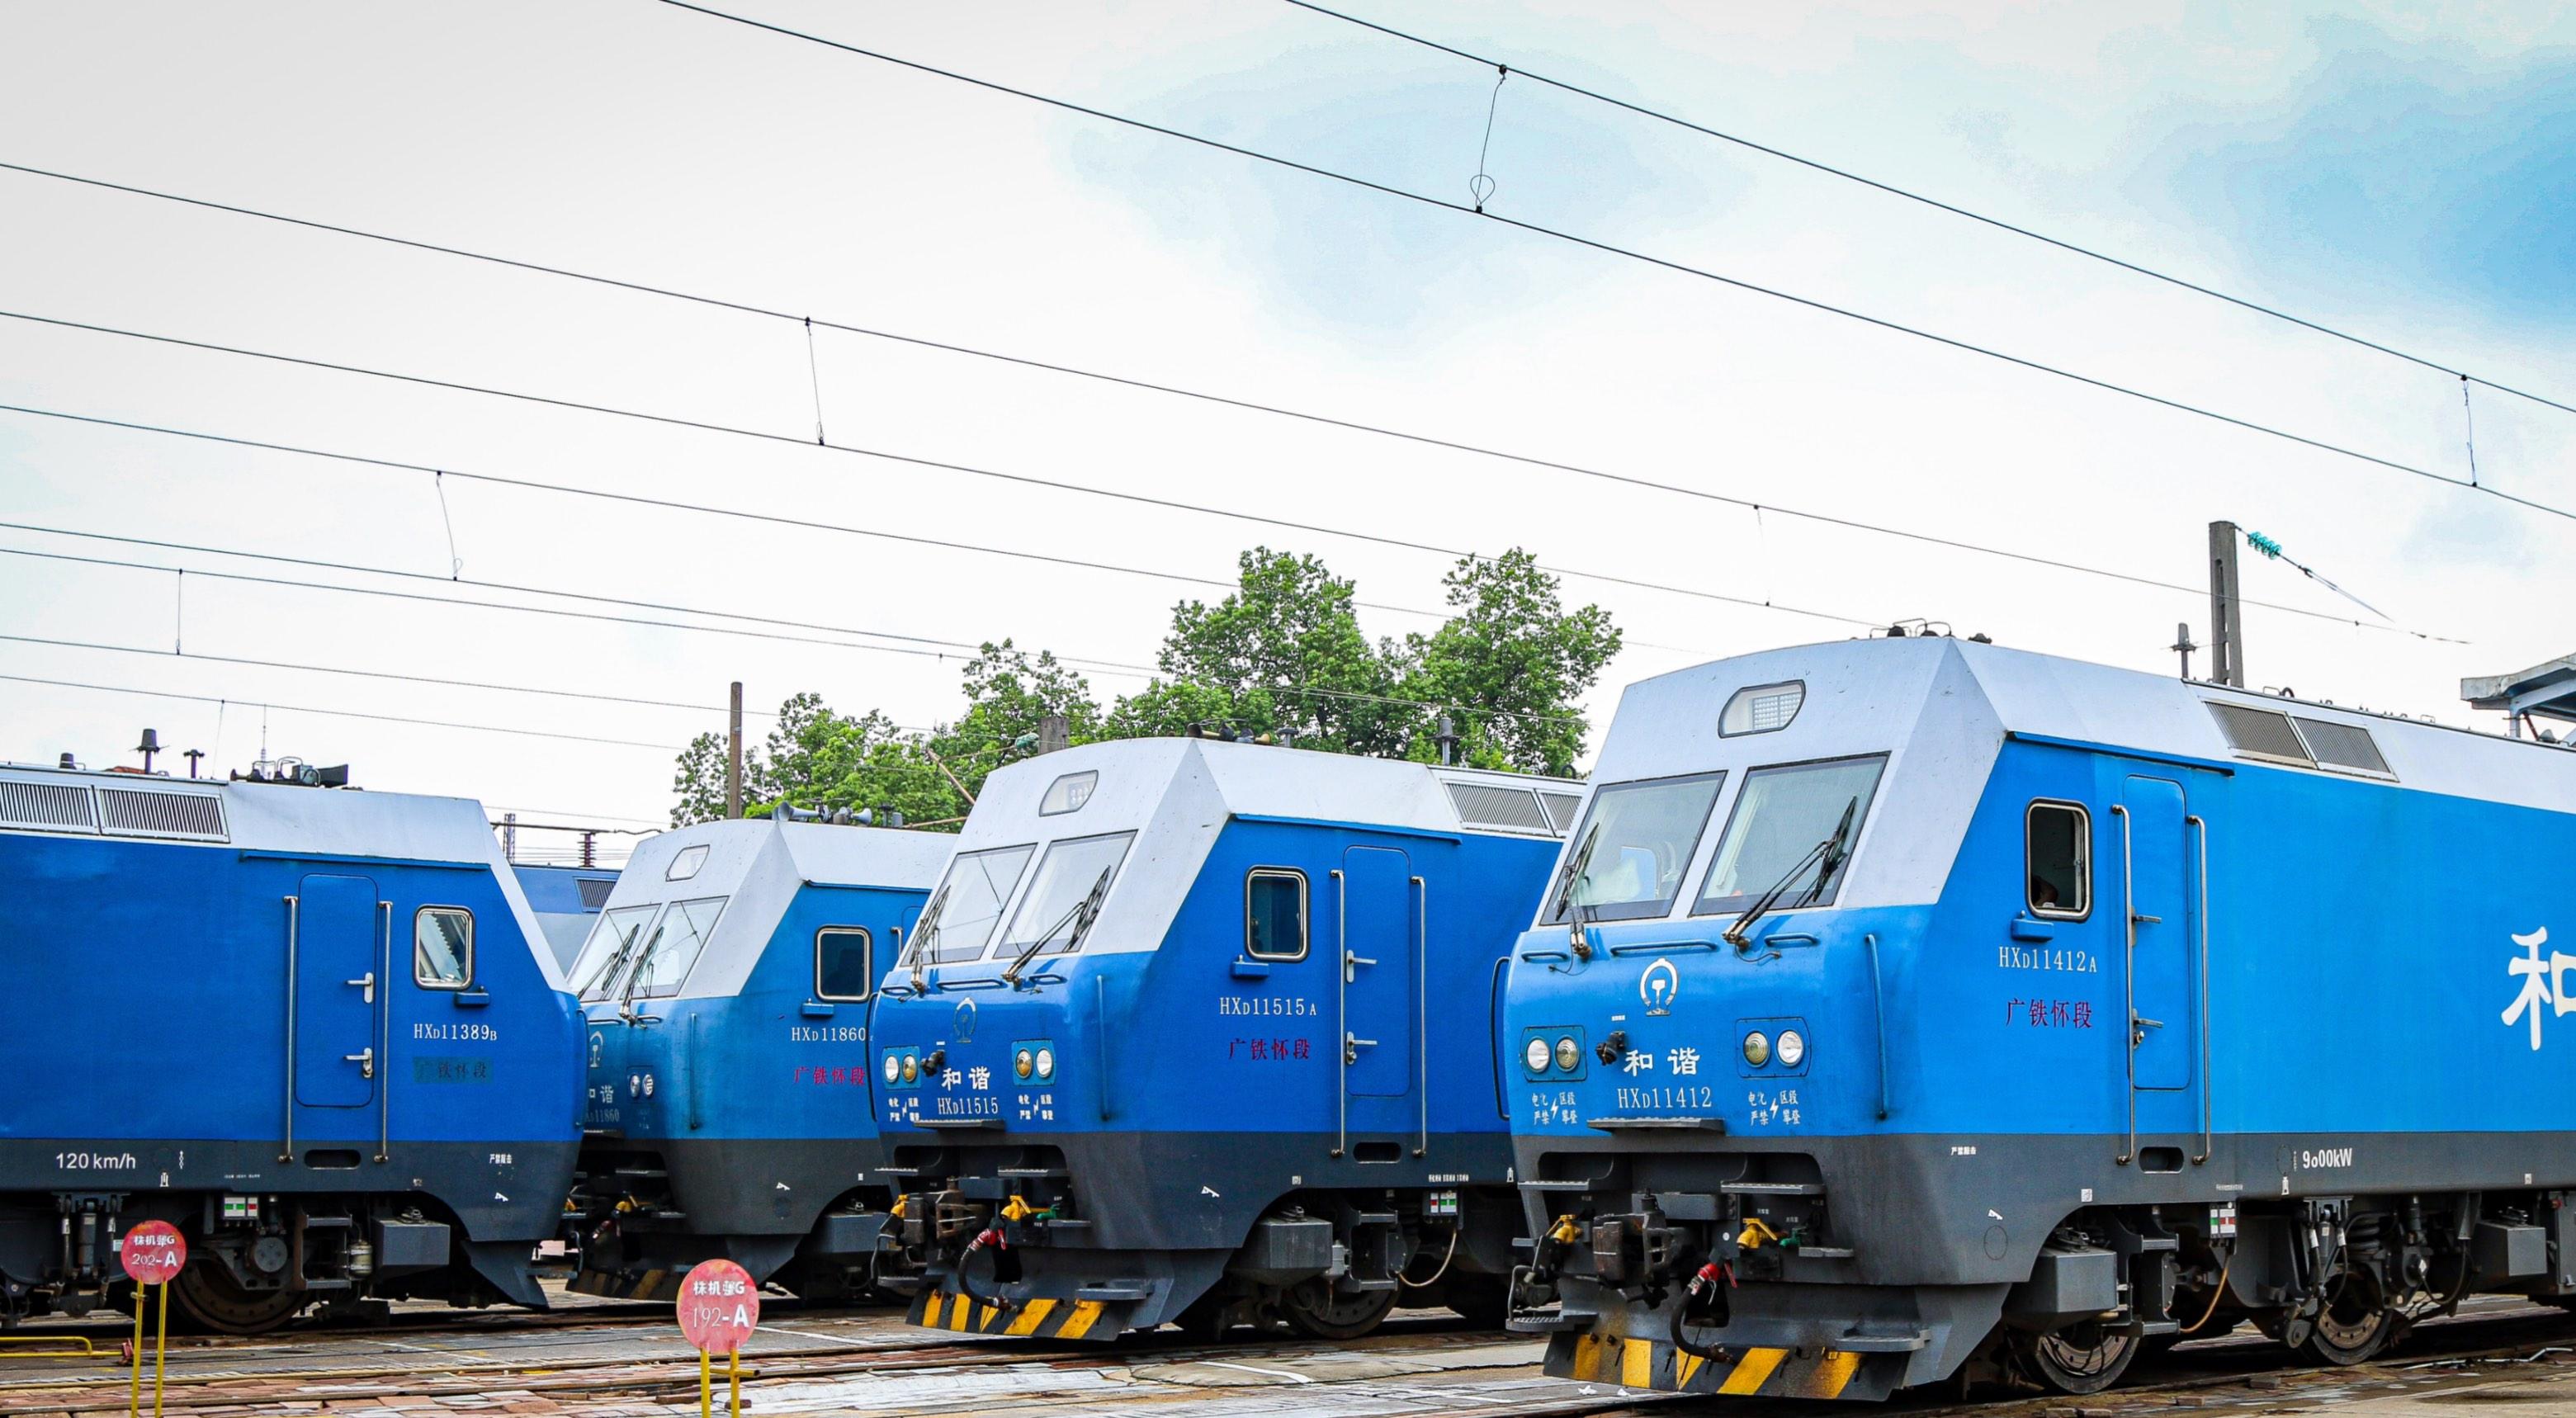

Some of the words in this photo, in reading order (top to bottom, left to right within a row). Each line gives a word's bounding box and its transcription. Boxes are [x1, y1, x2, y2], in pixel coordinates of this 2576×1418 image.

[1999, 946, 2096, 972] HXD11412A
[2501, 926, 2576, 1051] 和
[2006, 997, 2092, 1028] 广铁怀段
[414, 1023, 497, 1041] HXD11389B
[1228, 1038, 1311, 1060] 广铁怀段
[1624, 1047, 1700, 1077] 和谐
[793, 1066, 866, 1085] 广铁怀段
[941, 1066, 990, 1091] 和谐
[938, 1097, 999, 1114] HXD11515
[1618, 1086, 1712, 1108] HXD11412
[55, 1152, 89, 1169] 120
[93, 1152, 136, 1169] km/h
[132, 1250, 177, 1268] 202-A
[693, 1303, 750, 1328] 192-A
